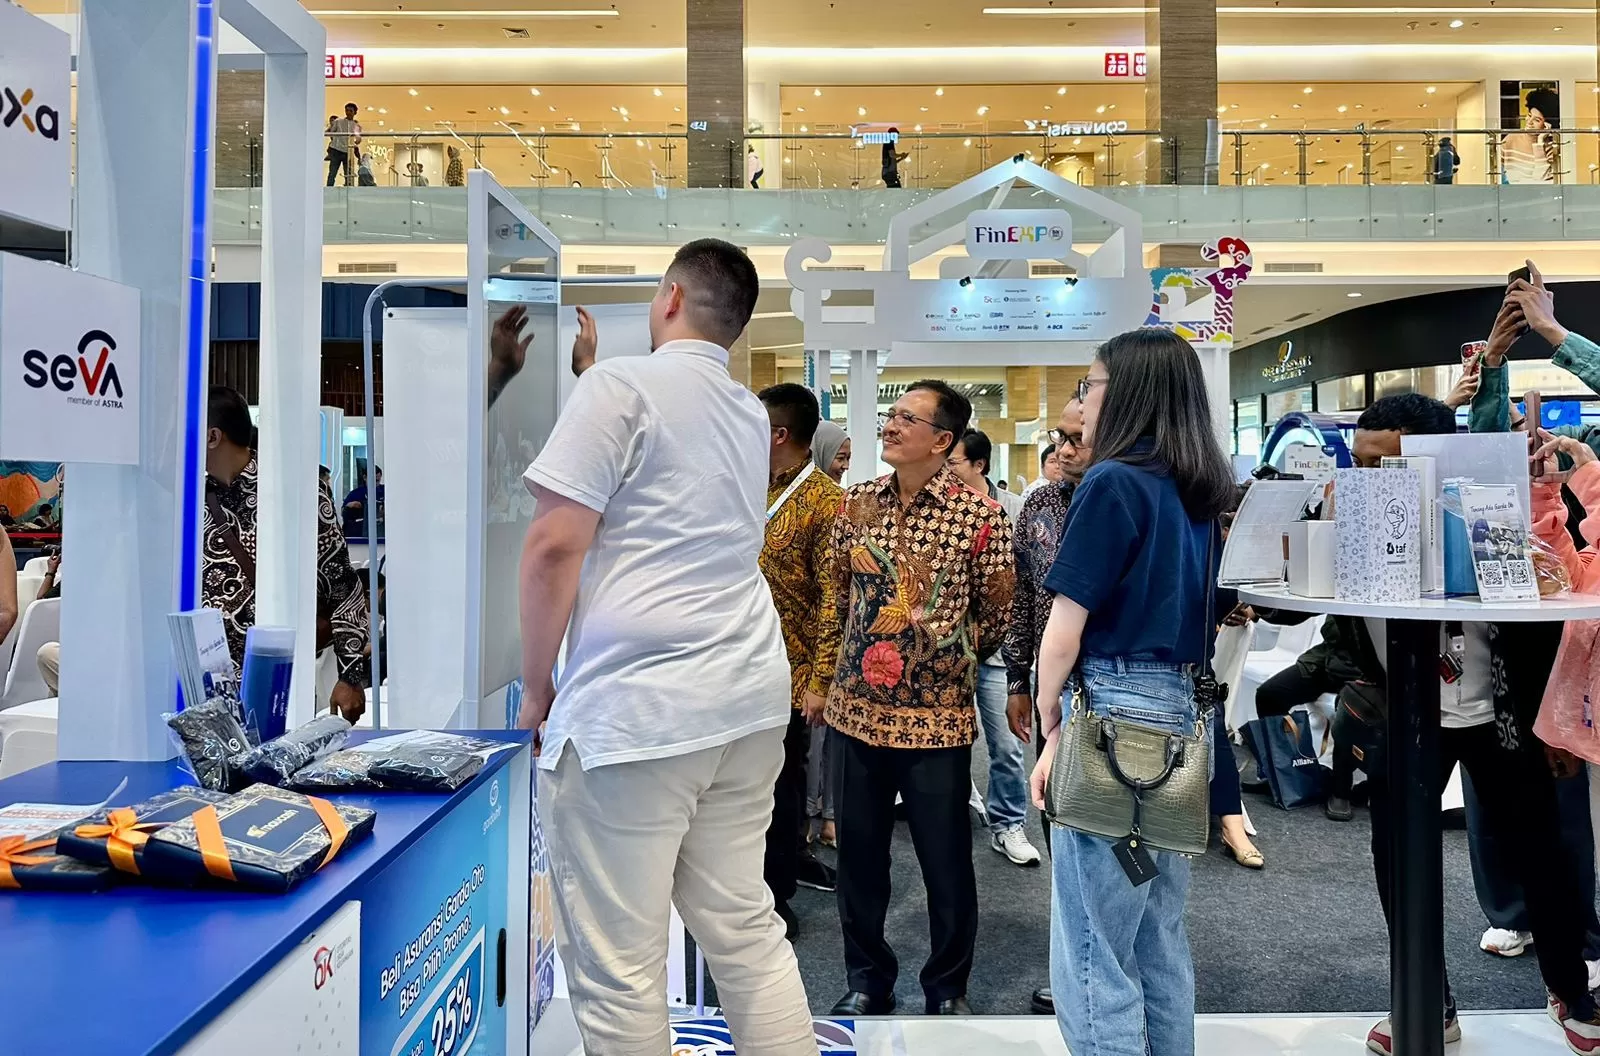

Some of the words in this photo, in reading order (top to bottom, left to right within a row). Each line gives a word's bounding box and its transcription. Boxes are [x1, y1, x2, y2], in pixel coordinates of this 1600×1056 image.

[341, 56, 361, 66] UNI
[341, 66, 362, 77] QLO
[0, 86, 59, 141] xa
[102, 400, 124, 409] ASTRA
[380, 951, 401, 1001] Beli
[402, 903, 444, 976] Asuransi
[445, 878, 470, 923] Garda
[471, 863, 486, 893] Oto
[399, 974, 421, 1019] Bisa
[422, 944, 442, 989] Pilih
[443, 905, 472, 963] Promo!
[431, 967, 472, 1056] 25%
